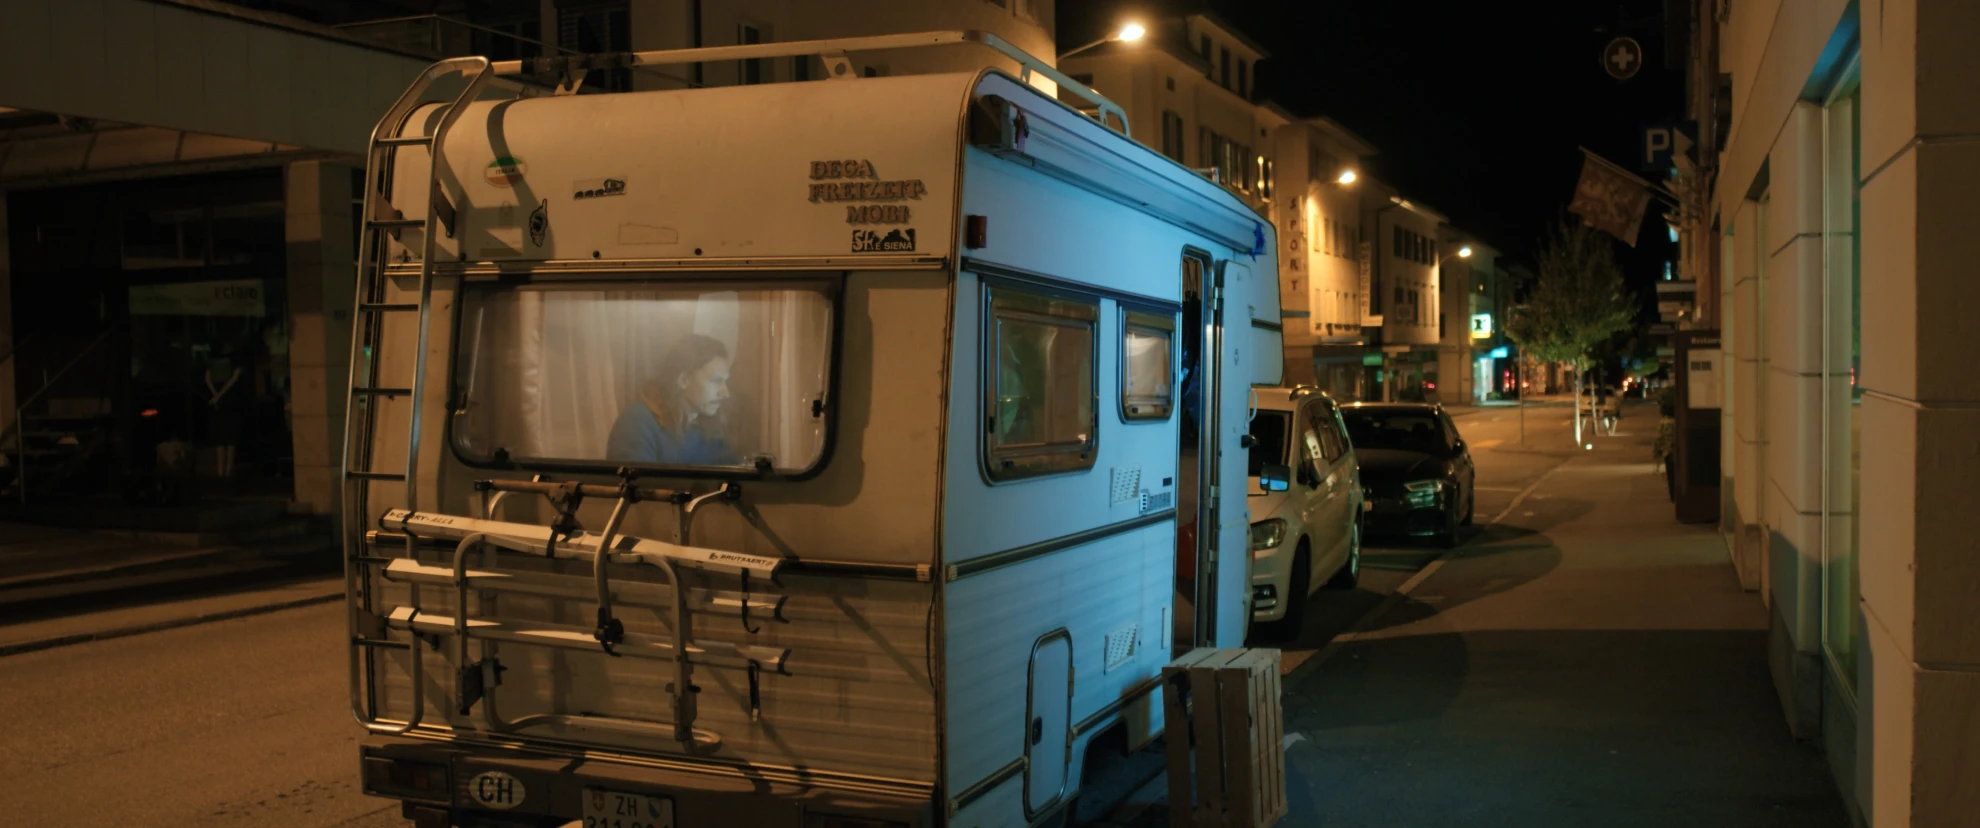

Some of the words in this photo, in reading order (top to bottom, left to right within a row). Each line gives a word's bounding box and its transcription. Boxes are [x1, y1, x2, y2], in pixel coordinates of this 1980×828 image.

[1646, 127, 1670, 163] P
[884, 241, 913, 250] SIENA
[1289, 198, 1299, 291] SPORT
[222, 284, 258, 300] claro
[720, 553, 766, 565] BRUTSAERT
[479, 776, 512, 804] CH
[615, 795, 637, 817] ZH
